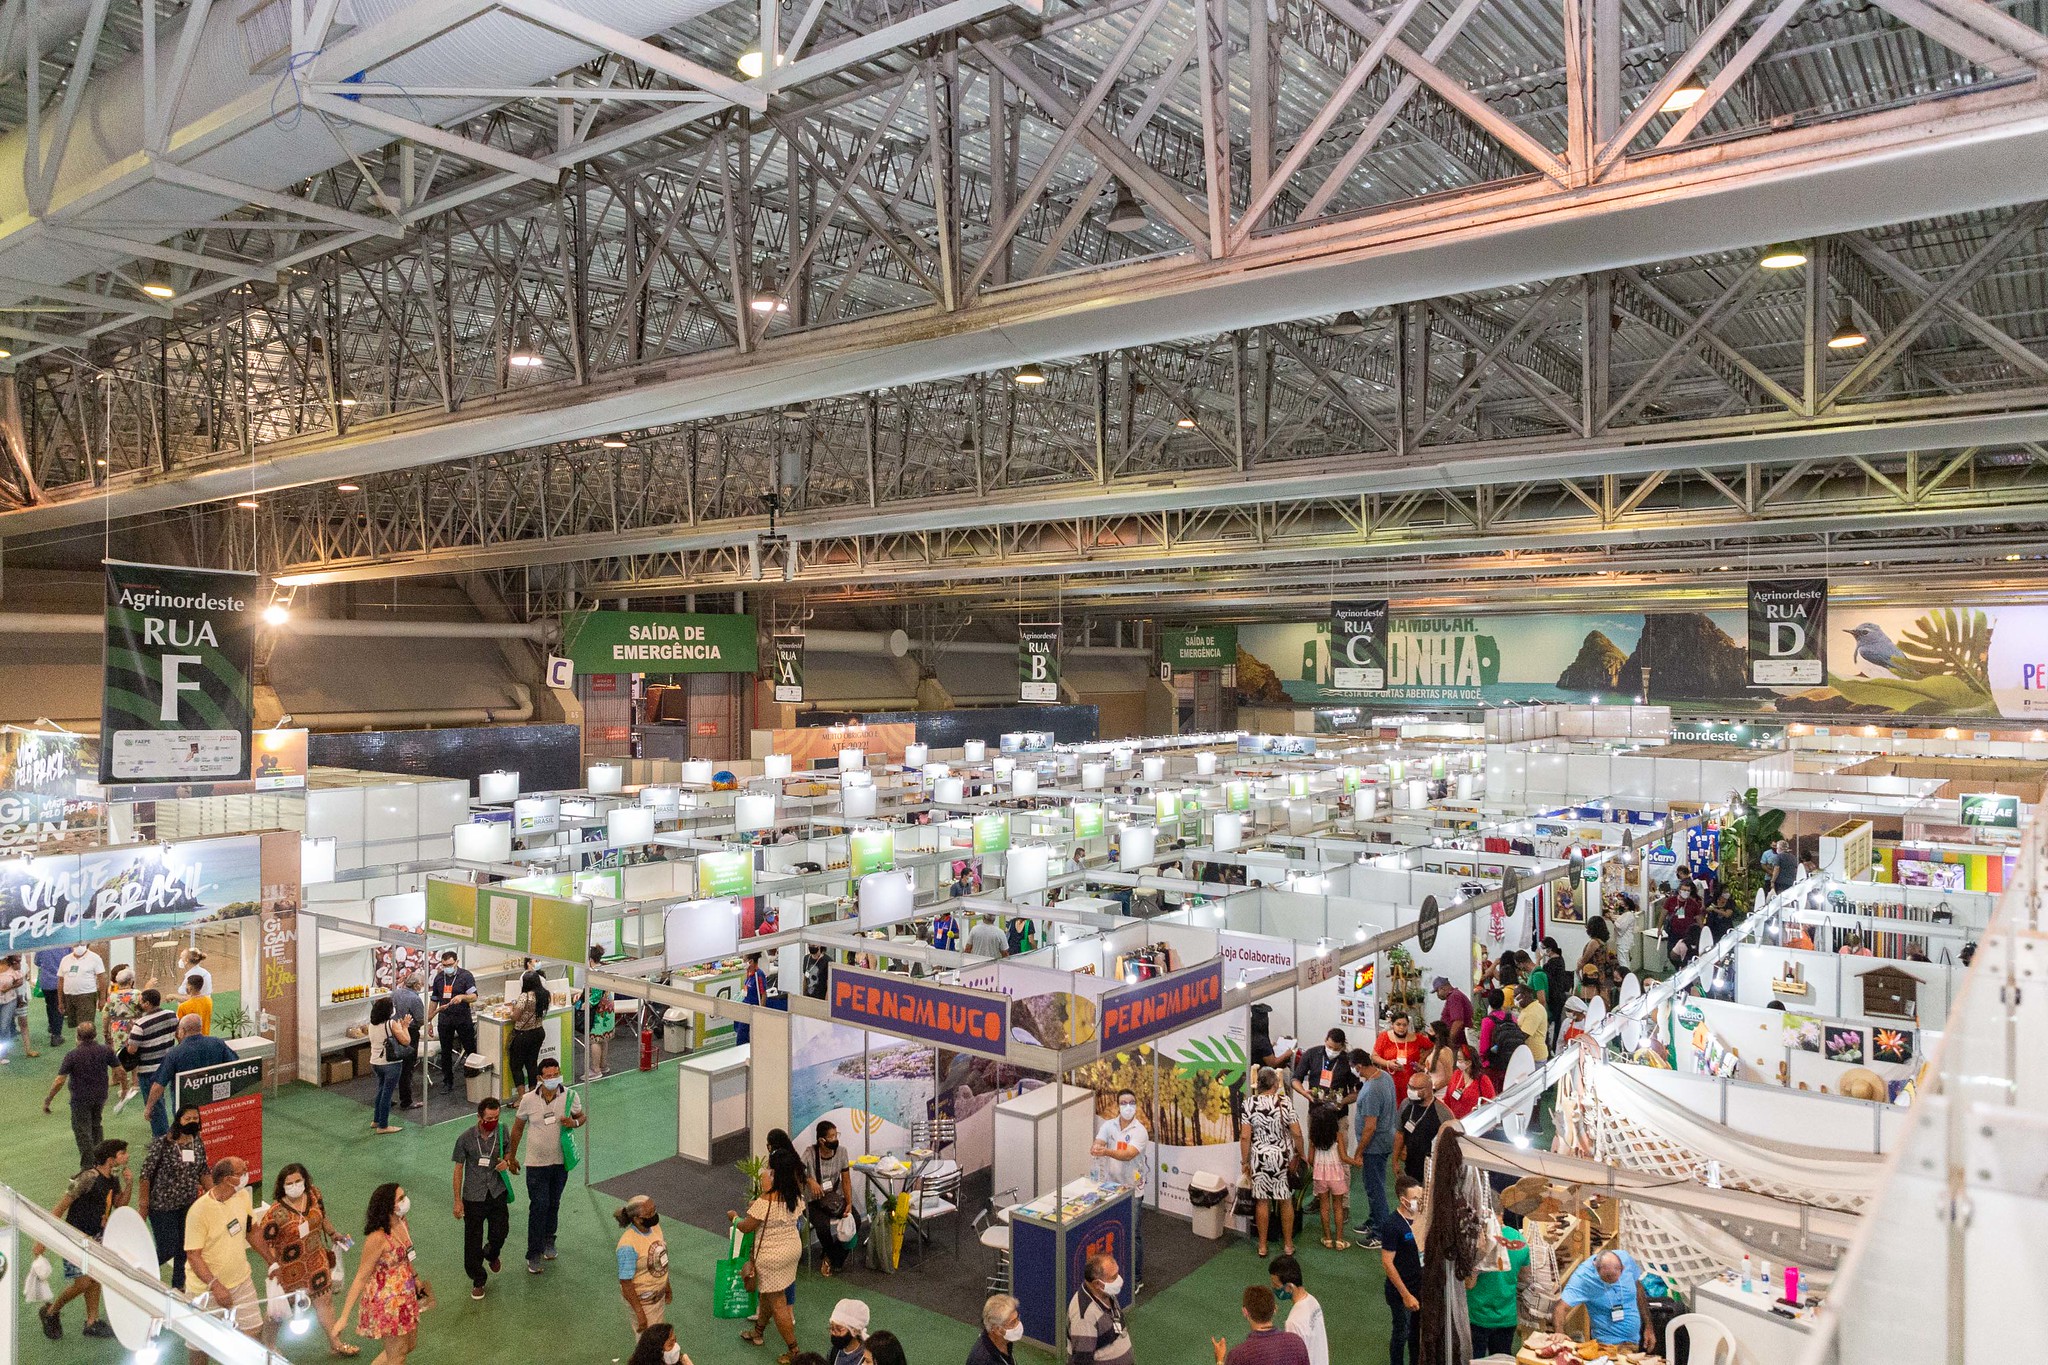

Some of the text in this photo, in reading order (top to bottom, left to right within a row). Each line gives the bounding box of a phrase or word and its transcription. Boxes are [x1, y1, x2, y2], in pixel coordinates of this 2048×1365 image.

[119, 588, 245, 612] Agrinordeste
[1753, 589, 1822, 603] Agrinordeste
[1335, 609, 1384, 619] Agrinordeste
[1766, 604, 1808, 619] RUA
[144, 617, 219, 648] RUA
[629, 622, 706, 641] SAÍDA DE
[1344, 621, 1374, 633] RUA
[1022, 631, 1058, 641] Agrinordeste
[1185, 635, 1215, 646] SAÍDA DE
[1768, 621, 1806, 656] D
[613, 642, 721, 660] EMERGÊNCIA
[1028, 642, 1050, 653] RUA
[1180, 646, 1221, 658] EMERGÊNCIA
[1346, 635, 1372, 665] C
[780, 651, 797, 661] RUA
[552, 661, 567, 686] C
[782, 661, 796, 684] A
[1032, 655, 1047, 680] B
[160, 654, 202, 721] F
[1406, 689, 1441, 699] ABERTAS
[1441, 690, 1459, 699] PRA
[1670, 729, 1738, 742] rinordeste
[1965, 806, 2014, 818] SEBRAE
[533, 817, 554, 826] BRASIL
[1653, 852, 1676, 863] Carro
[20, 859, 113, 912] VIAJE
[8, 901, 82, 949] PELO
[263, 944, 286, 959] TE
[1220, 945, 1292, 967] Loja Colaborativa
[184, 1065, 259, 1090] Agrinordeste
[202, 1124, 224, 1133] ATUREZA
